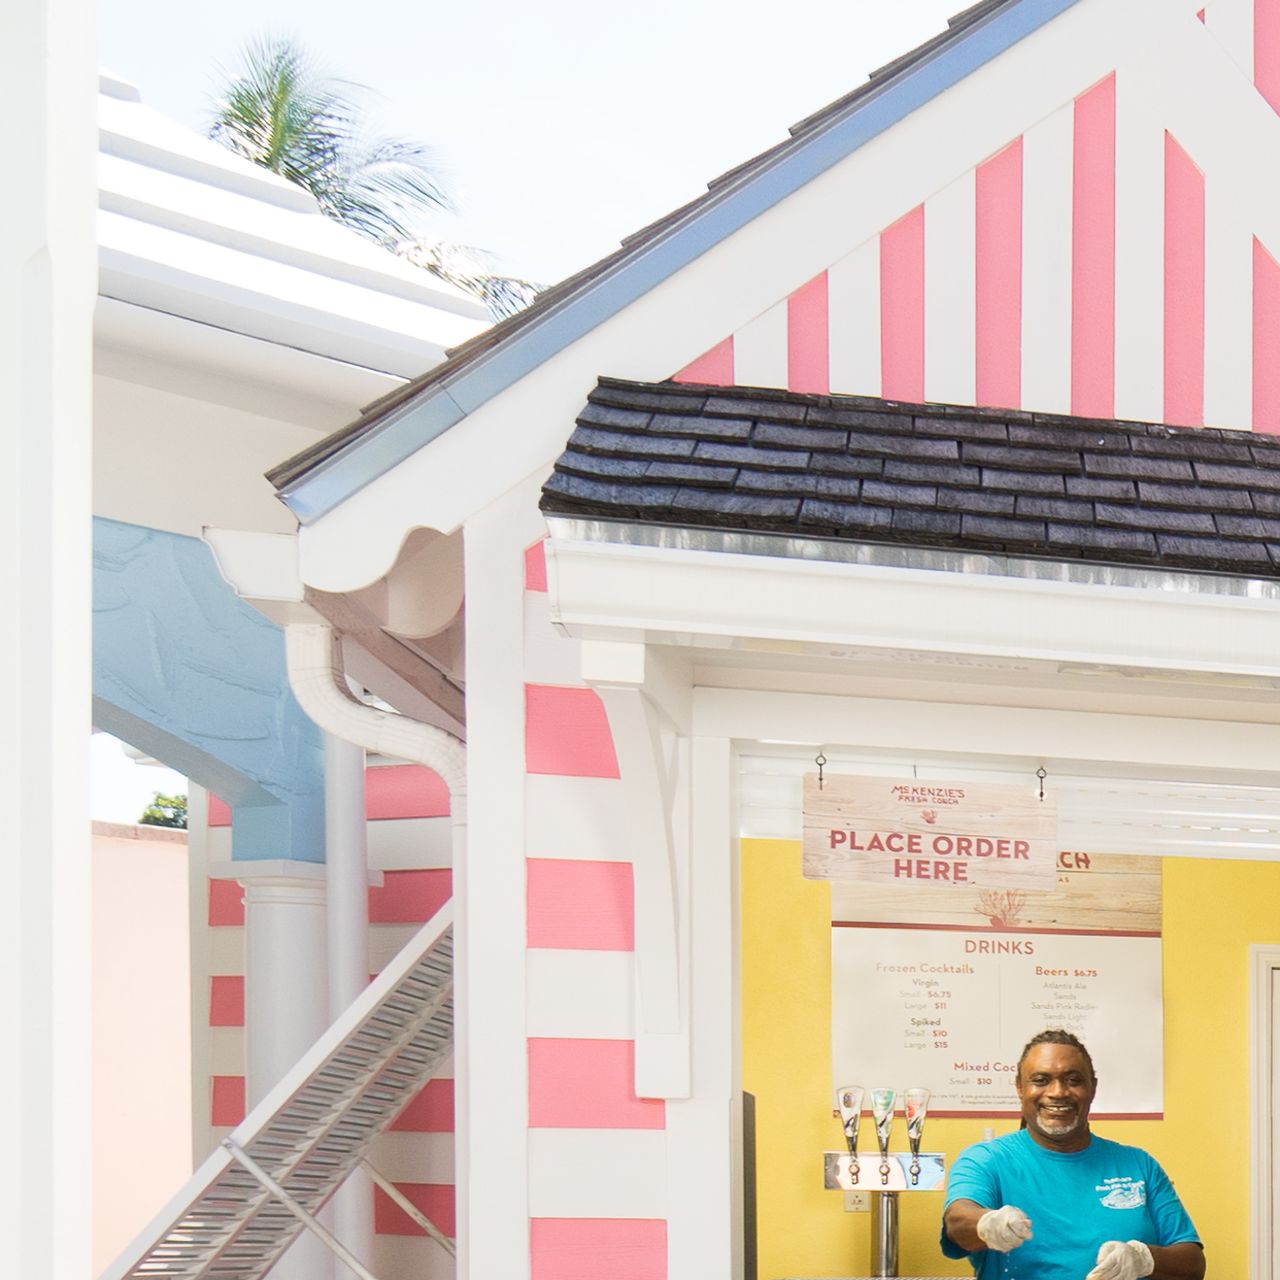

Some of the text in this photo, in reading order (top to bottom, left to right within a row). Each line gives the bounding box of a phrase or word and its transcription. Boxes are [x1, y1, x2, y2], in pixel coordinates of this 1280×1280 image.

[830, 830, 923, 854] PLACE
[932, 836, 1031, 861] ORDER
[894, 858, 969, 882] HERE
[964, 939, 1035, 955] DRINKS
[876, 962, 975, 974] Frozen Cocktails
[1035, 966, 1098, 977] Beers $6.75
[912, 978, 940, 988] Virgin
[910, 1017, 942, 1027] Spiked
[932, 1030, 948, 1038] $10
[934, 1041, 948, 1049] $15
[953, 1061, 990, 1072] Mixed
[976, 1077, 993, 1086] $10
